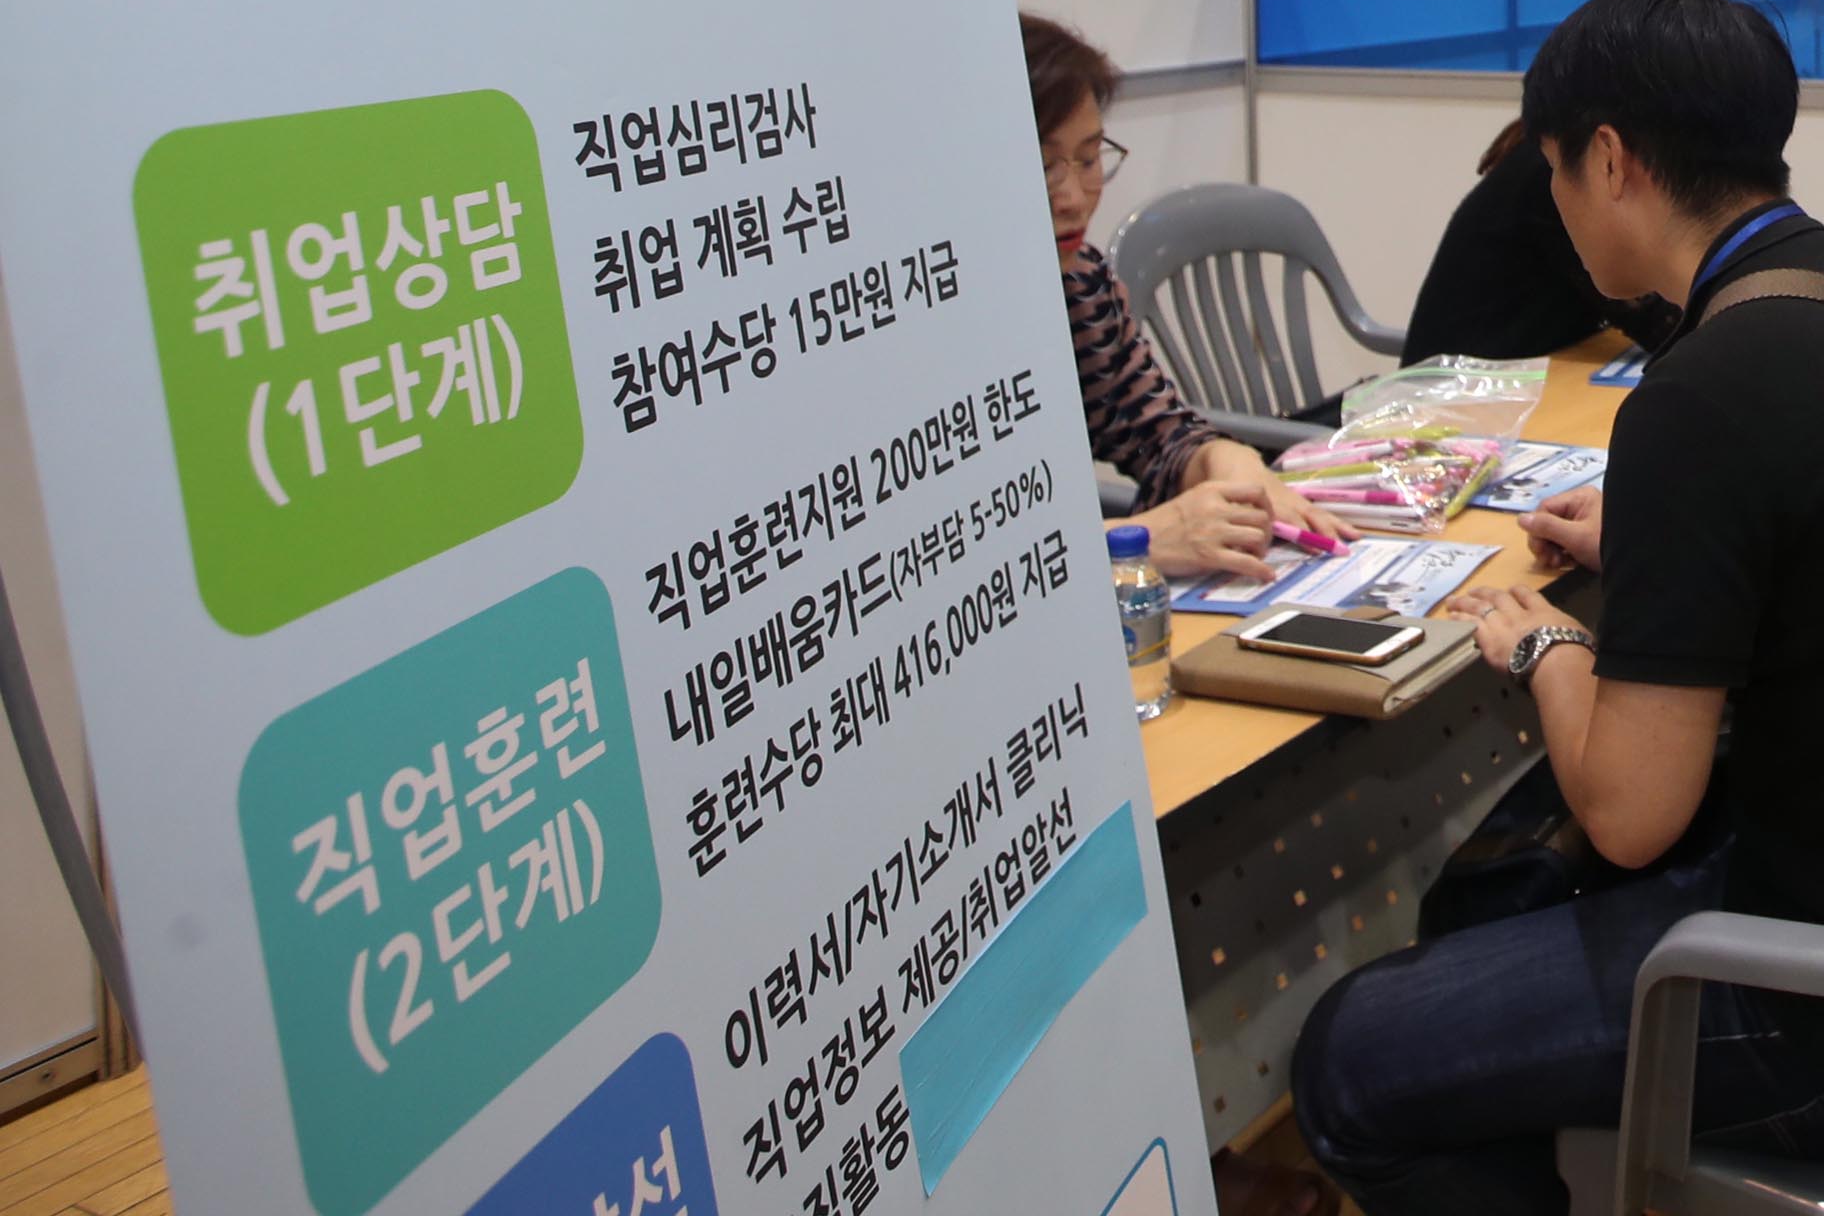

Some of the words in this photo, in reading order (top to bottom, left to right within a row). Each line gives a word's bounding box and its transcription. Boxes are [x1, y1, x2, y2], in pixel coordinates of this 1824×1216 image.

[572, 82, 817, 192] 직업심리검사
[593, 218, 684, 314] 취업
[697, 195, 773, 278] 계획
[782, 175, 851, 254] 수립
[193, 181, 523, 359] 취업상담
[611, 303, 777, 433] 참여수당
[789, 259, 897, 354] 15만원
[901, 239, 959, 310] 지급
[247, 313, 523, 507] (1단계)
[644, 455, 866, 631] 직업훈련지원
[870, 394, 981, 505] 200만원
[983, 369, 1042, 442] 한도
[971, 458, 1054, 542] 5-50%)
[292, 656, 606, 916] 직업훈련
[686, 707, 823, 878] 훈련수당
[830, 656, 890, 753] 최대
[893, 560, 1018, 700] 416,000원
[1021, 529, 1069, 600] 지급
[349, 799, 604, 1074] (2단계)
[725, 756, 1003, 1069] 이력서/자기소개서
[1005, 682, 1089, 798] 클리닉
[743, 985, 896, 1184] 직업정보
[898, 786, 1078, 1015] 제공/취업알선
